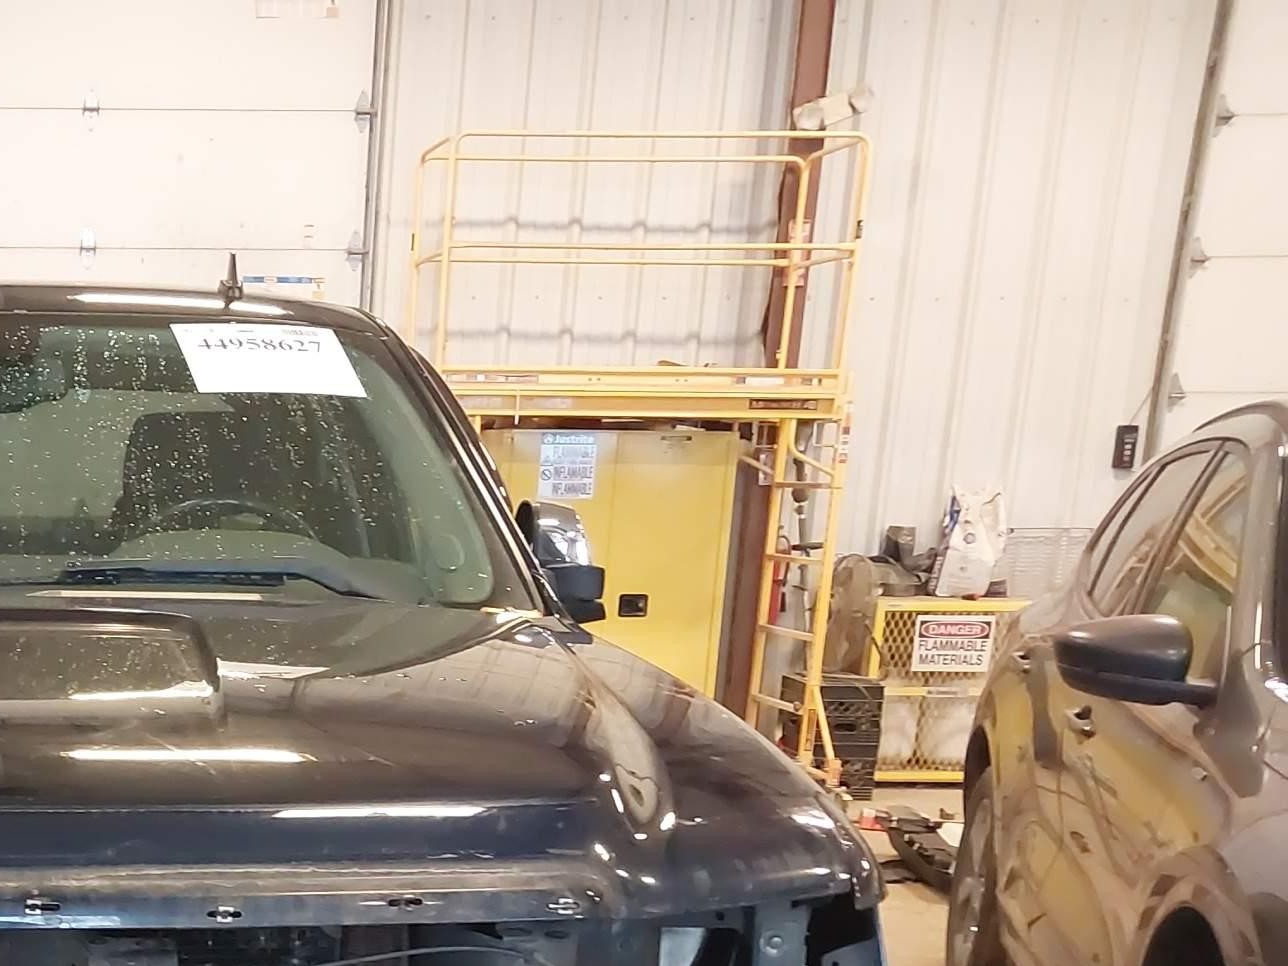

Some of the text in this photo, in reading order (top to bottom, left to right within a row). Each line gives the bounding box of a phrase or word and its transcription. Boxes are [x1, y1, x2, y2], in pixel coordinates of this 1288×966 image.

[198, 337, 321, 352] 44958627
[929, 624, 982, 635] DANGER
[919, 640, 987, 652] FLAMMABLE
[919, 653, 984, 666] MATERIALS
